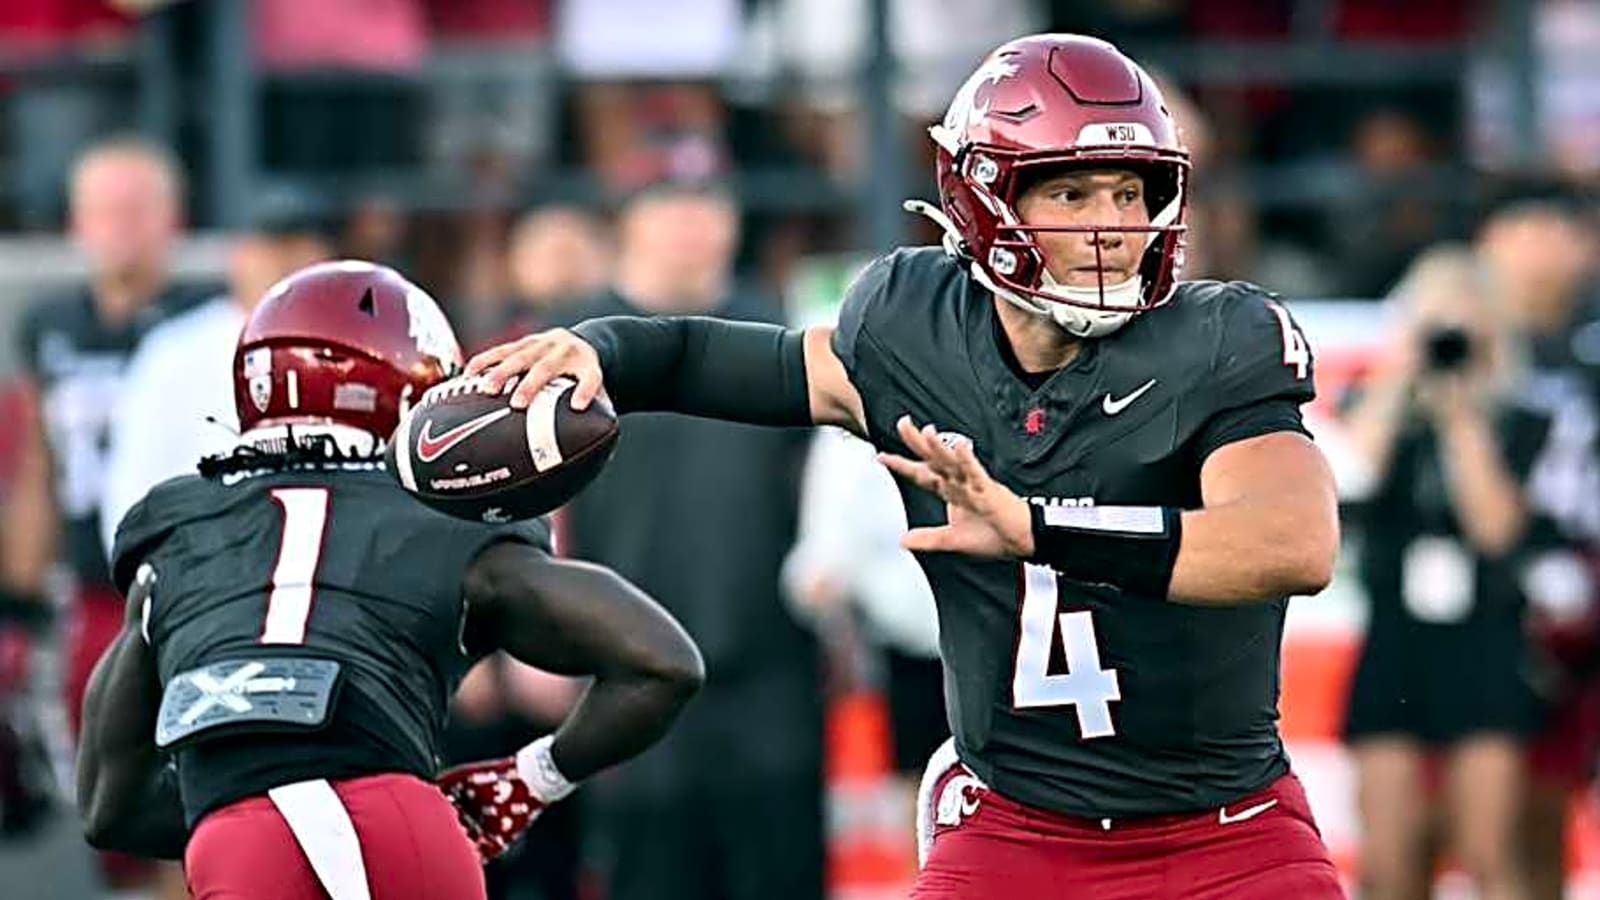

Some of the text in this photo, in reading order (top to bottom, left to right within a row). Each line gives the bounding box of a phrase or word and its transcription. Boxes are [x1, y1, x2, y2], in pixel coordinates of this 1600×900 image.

[1106, 125, 1136, 142] WSU
[1265, 302, 1310, 380] 4
[260, 486, 330, 645] 1
[1012, 561, 1122, 739] 4
